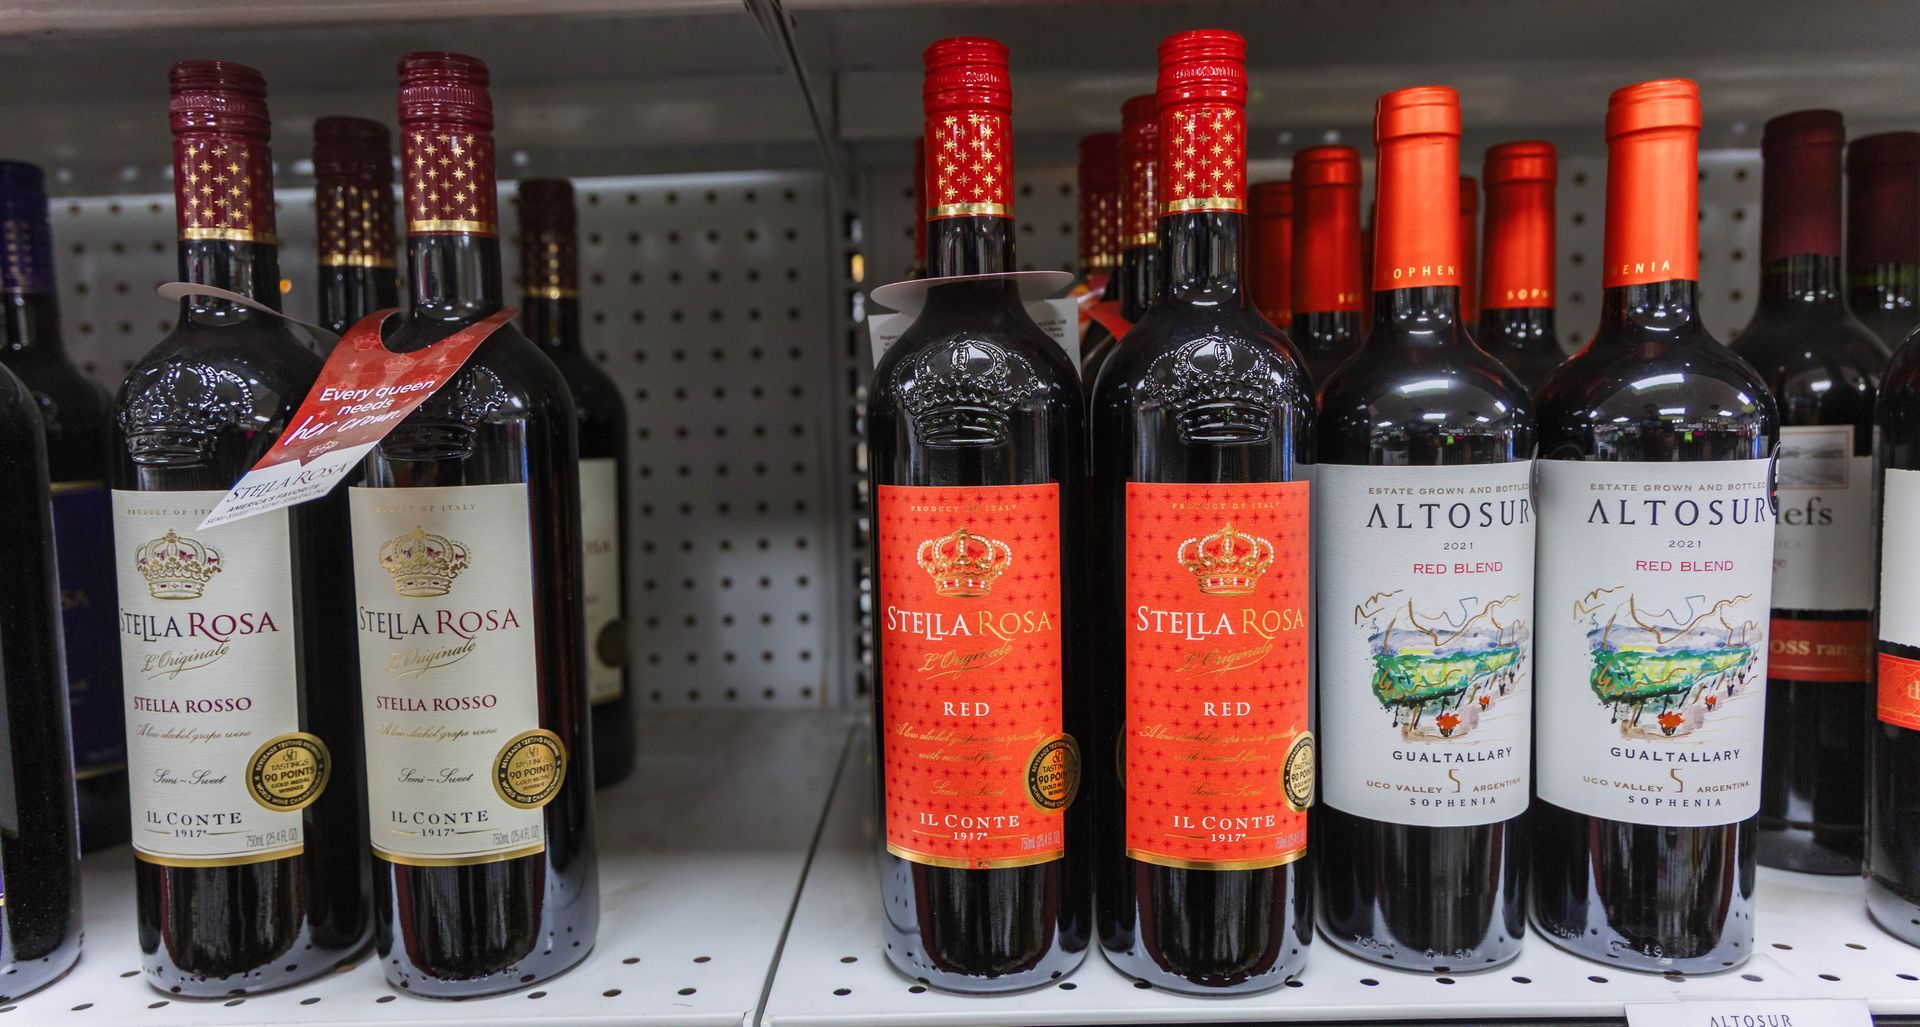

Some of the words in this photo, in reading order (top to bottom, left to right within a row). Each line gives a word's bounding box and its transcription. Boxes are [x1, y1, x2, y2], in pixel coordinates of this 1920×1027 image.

[319, 386, 373, 402] Every
[375, 380, 436, 399] queen
[336, 398, 395, 416] needs
[283, 415, 338, 446] her
[226, 476, 292, 503] STELLA
[292, 462, 347, 486] ROSA
[1368, 487, 1414, 496] ESTATE
[1414, 486, 1465, 495] GROWN
[1469, 485, 1492, 494] AND
[1590, 483, 1638, 492] ESTATE
[1643, 483, 1693, 492] GROWN
[1697, 482, 1723, 491] AND
[127, 508, 168, 516] PRODUCT
[420, 504, 435, 512] OF
[441, 503, 477, 512] ITALY
[910, 505, 959, 513] PRODUCT
[985, 504, 1017, 512] ITALY
[1171, 502, 1226, 510] PRODUCT
[1232, 502, 1246, 510] OF
[1252, 501, 1281, 510] ITALY
[1366, 498, 1530, 529] ALTOSUR
[1586, 497, 1766, 526] ALTOSUR
[1443, 542, 1474, 550] 2021
[1668, 540, 1702, 548] 2021
[1413, 563, 1447, 575] RED
[1454, 561, 1504, 574] BLEND
[1635, 560, 1673, 572] RED
[1680, 560, 1735, 572] BLEND
[186, 611, 280, 643] ROSA
[359, 606, 431, 641] STELLA
[436, 608, 521, 640] ROSA
[887, 605, 973, 641] STELLA
[978, 610, 1053, 642] ROSA
[1136, 605, 1236, 641] STELLA
[1242, 608, 1305, 640] ROSA
[140, 637, 231, 680] L'Originale
[133, 695, 180, 713] STELLA
[185, 696, 252, 714] ROSSO
[376, 695, 427, 712] STELLA
[432, 694, 498, 712] ROSSO
[943, 701, 990, 717] RED
[1203, 701, 1251, 717] RED
[160, 726, 191, 740] alcohol
[191, 730, 221, 744] grape
[224, 729, 252, 739] wine
[440, 728, 469, 743] grape
[1392, 747, 1513, 763] GUALTALLARY
[1610, 747, 1741, 763] GUALTALLARY
[264, 773, 278, 784] 90
[280, 766, 315, 780] POINTS
[509, 770, 522, 780] 90
[524, 762, 554, 777] POINTS
[1290, 772, 1299, 783] 90
[271, 781, 289, 789] GOLD
[515, 778, 532, 786] GOLD
[1038, 774, 1050, 785] 90
[1042, 783, 1057, 791] GOLD
[1366, 780, 1391, 790] UCO
[1396, 784, 1443, 794] VALLEY
[1472, 777, 1521, 793] ARGENTINA
[1582, 775, 1608, 786] UCO
[1612, 781, 1664, 793] VALLEY
[1697, 780, 1750, 793] ARGENTINA
[1409, 796, 1497, 808] SOPHENIA
[1628, 795, 1722, 807] SOPHENIA
[147, 810, 162, 825] IL
[166, 811, 243, 826] CONTE
[391, 810, 408, 824] IL
[413, 810, 489, 825] CONTE
[919, 812, 939, 827] IL
[944, 814, 1021, 829] CONTE
[1173, 815, 1195, 829] IL
[1201, 815, 1276, 830] CONTE
